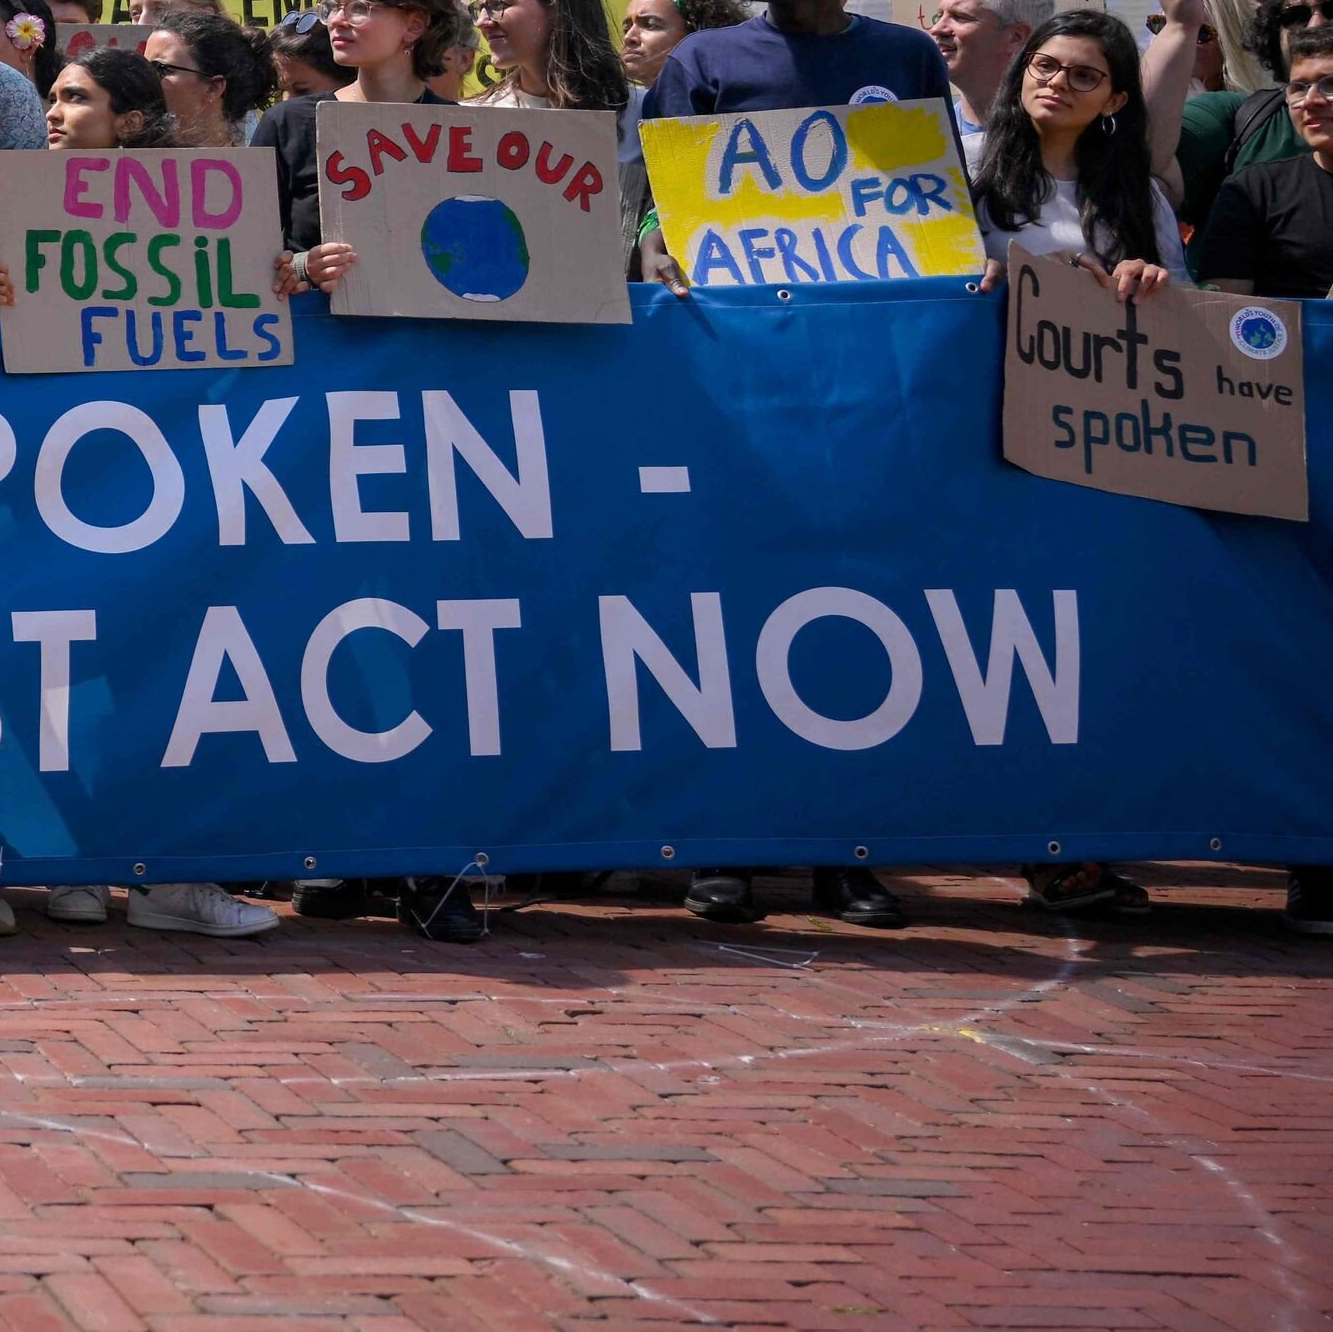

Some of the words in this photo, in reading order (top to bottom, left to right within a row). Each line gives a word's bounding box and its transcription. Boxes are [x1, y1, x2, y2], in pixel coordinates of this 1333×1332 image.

[326, 122, 483, 201] SAVE
[497, 130, 603, 212] OUR
[718, 110, 848, 194] AO
[64, 157, 242, 229] END
[851, 173, 953, 217] FOR
[692, 224, 921, 286] AFRICA
[82, 307, 280, 366] FUELS
[1016, 264, 1184, 400] Courts
[1216, 364, 1294, 406] have
[1052, 398, 1257, 475] spoken
[161, 597, 522, 768] ACT
[598, 585, 1080, 751] NOW
